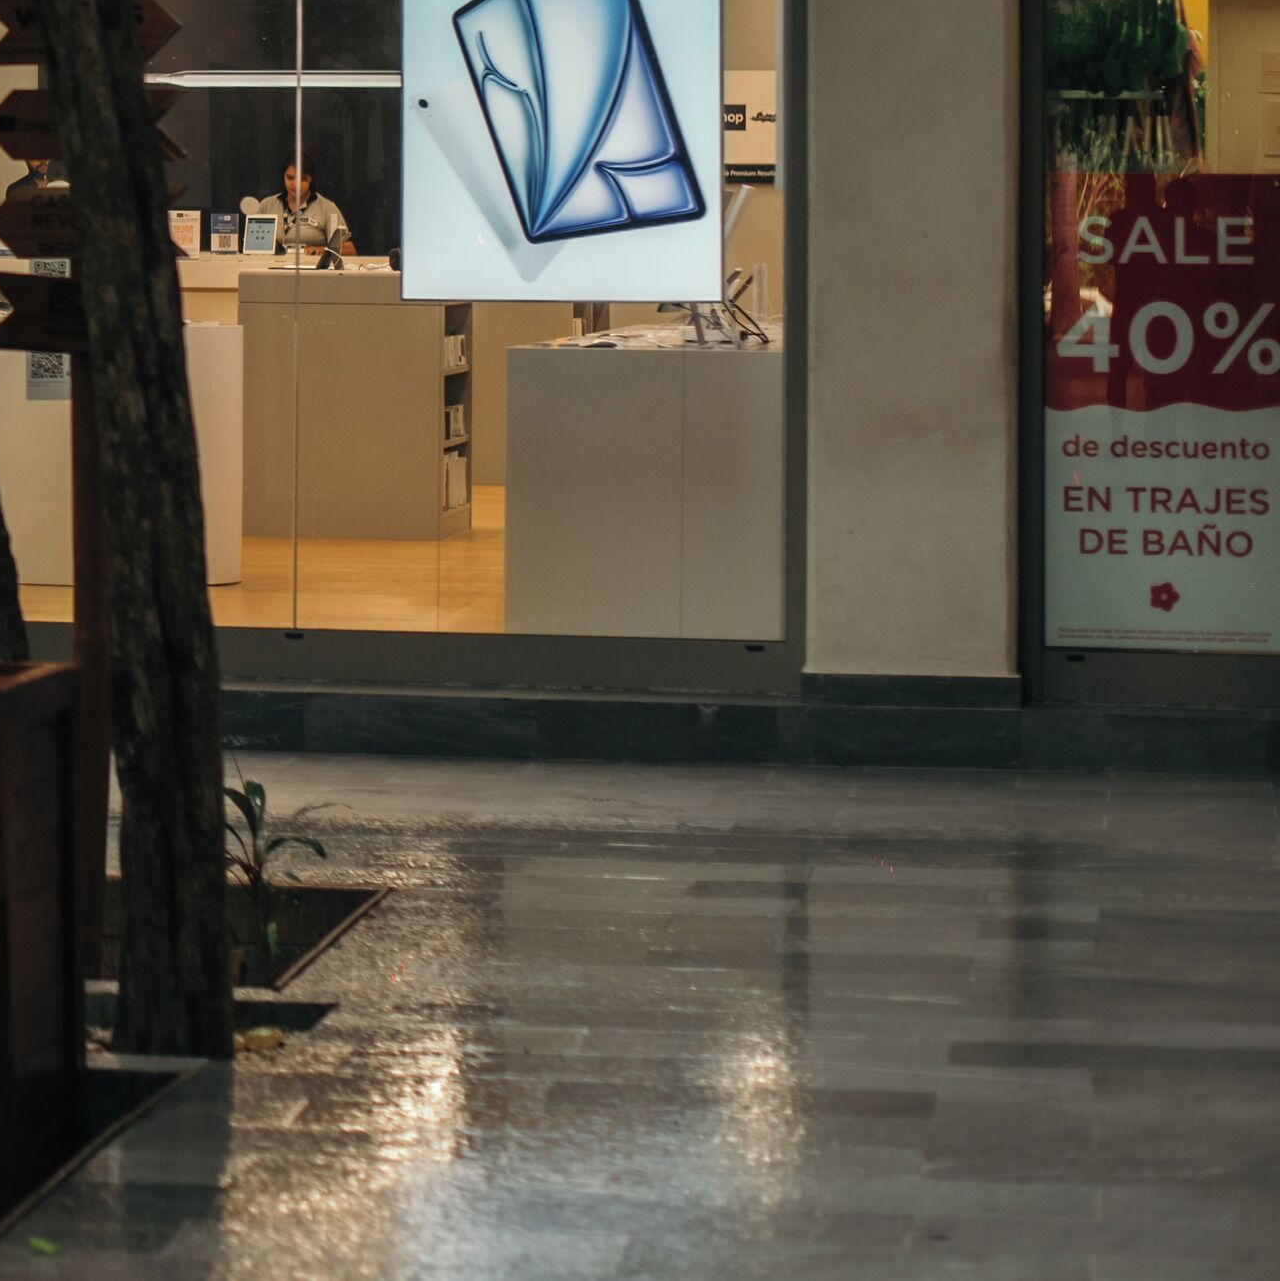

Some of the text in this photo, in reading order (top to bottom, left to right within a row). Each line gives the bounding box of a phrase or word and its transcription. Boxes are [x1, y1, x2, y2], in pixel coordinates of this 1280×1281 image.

[1077, 215, 1255, 265] SALE
[1056, 300, 1280, 375] 40%
[1062, 435, 1270, 460] de descuento
[1063, 485, 1270, 516] EN TRAJES
[1079, 523, 1253, 558] DE BAÑO
